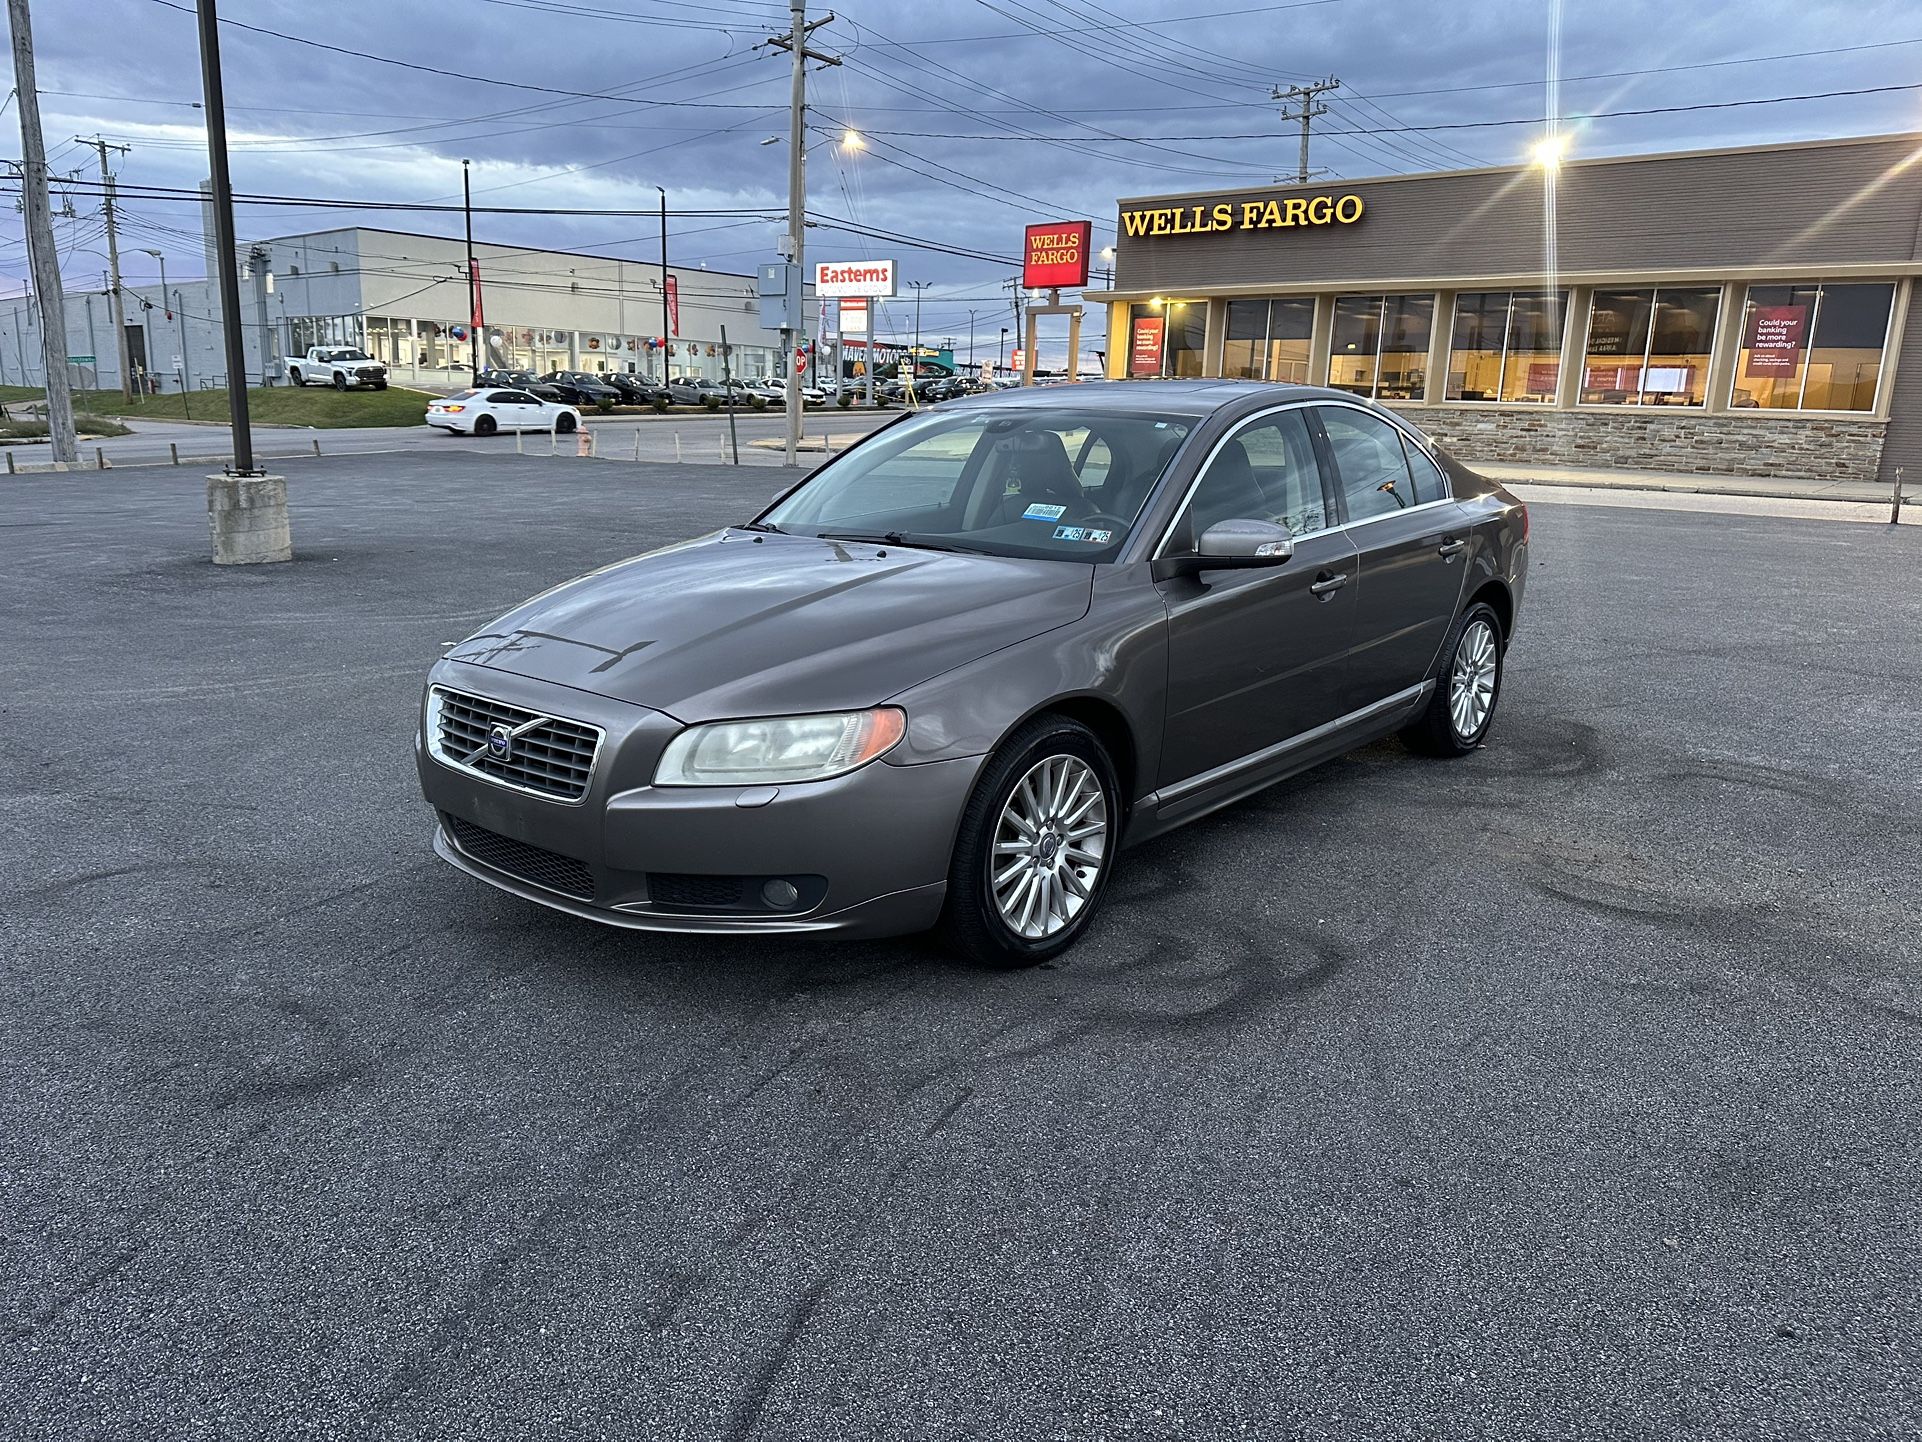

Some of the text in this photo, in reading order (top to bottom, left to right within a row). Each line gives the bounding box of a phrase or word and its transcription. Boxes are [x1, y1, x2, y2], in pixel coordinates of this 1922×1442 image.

[1122, 195, 1363, 236] WELLS FARGO
[1031, 233, 1079, 249] WELLS
[1031, 250, 1077, 264] FARGO
[821, 266, 888, 283] Easterns
[1756, 341, 1796, 349] rewarding?
[796, 356, 805, 366] OP
